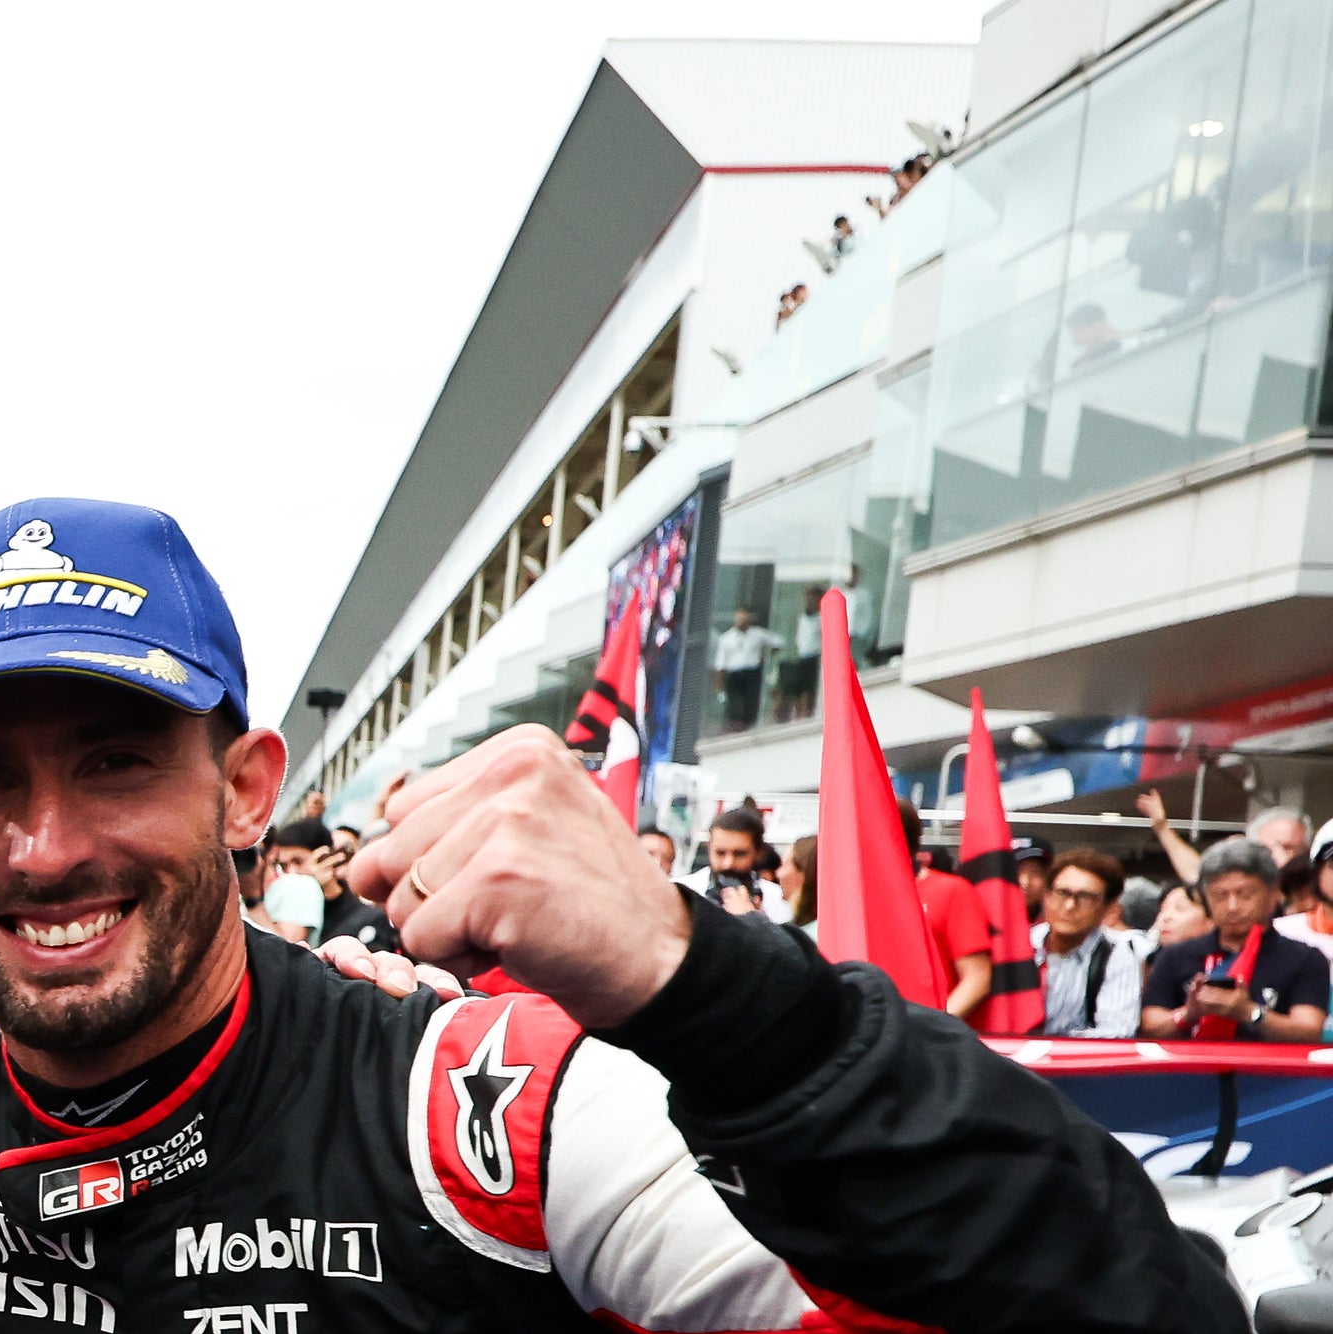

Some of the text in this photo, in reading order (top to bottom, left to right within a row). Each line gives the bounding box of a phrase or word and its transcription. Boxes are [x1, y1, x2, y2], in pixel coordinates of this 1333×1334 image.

[125, 1112, 205, 1165] TOYOTA
[129, 1130, 204, 1182] GAZOO
[42, 1175, 122, 1215] GR
[131, 1148, 208, 1197] Racing
[175, 1217, 316, 1277] Mobil
